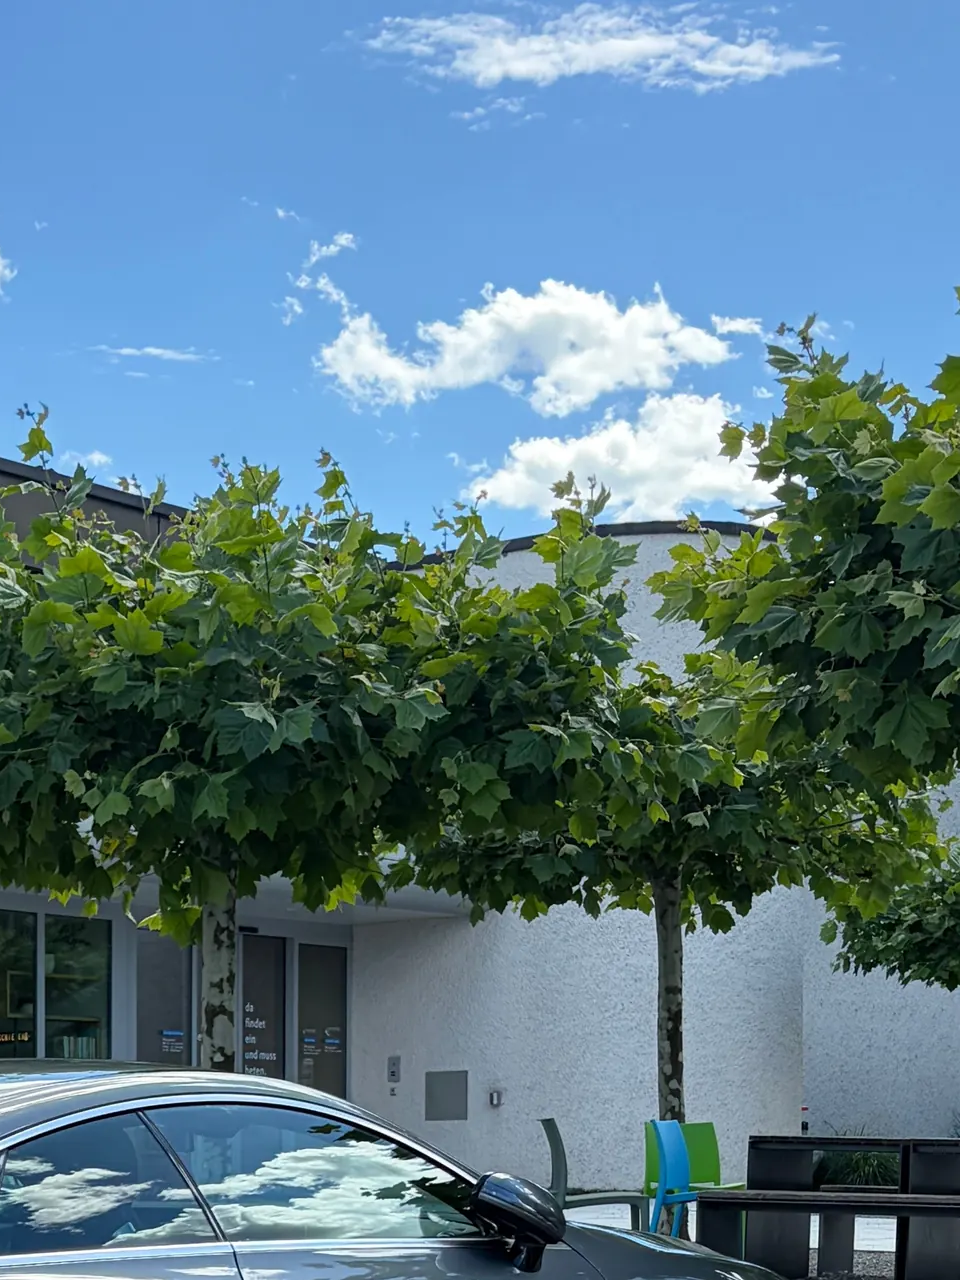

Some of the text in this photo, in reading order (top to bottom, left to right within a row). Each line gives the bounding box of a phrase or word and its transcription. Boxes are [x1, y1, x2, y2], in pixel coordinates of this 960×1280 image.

[245, 1002, 254, 1013] da
[245, 1017, 266, 1029] findet
[245, 1034, 256, 1044] ein
[245, 1049, 276, 1061] und muss
